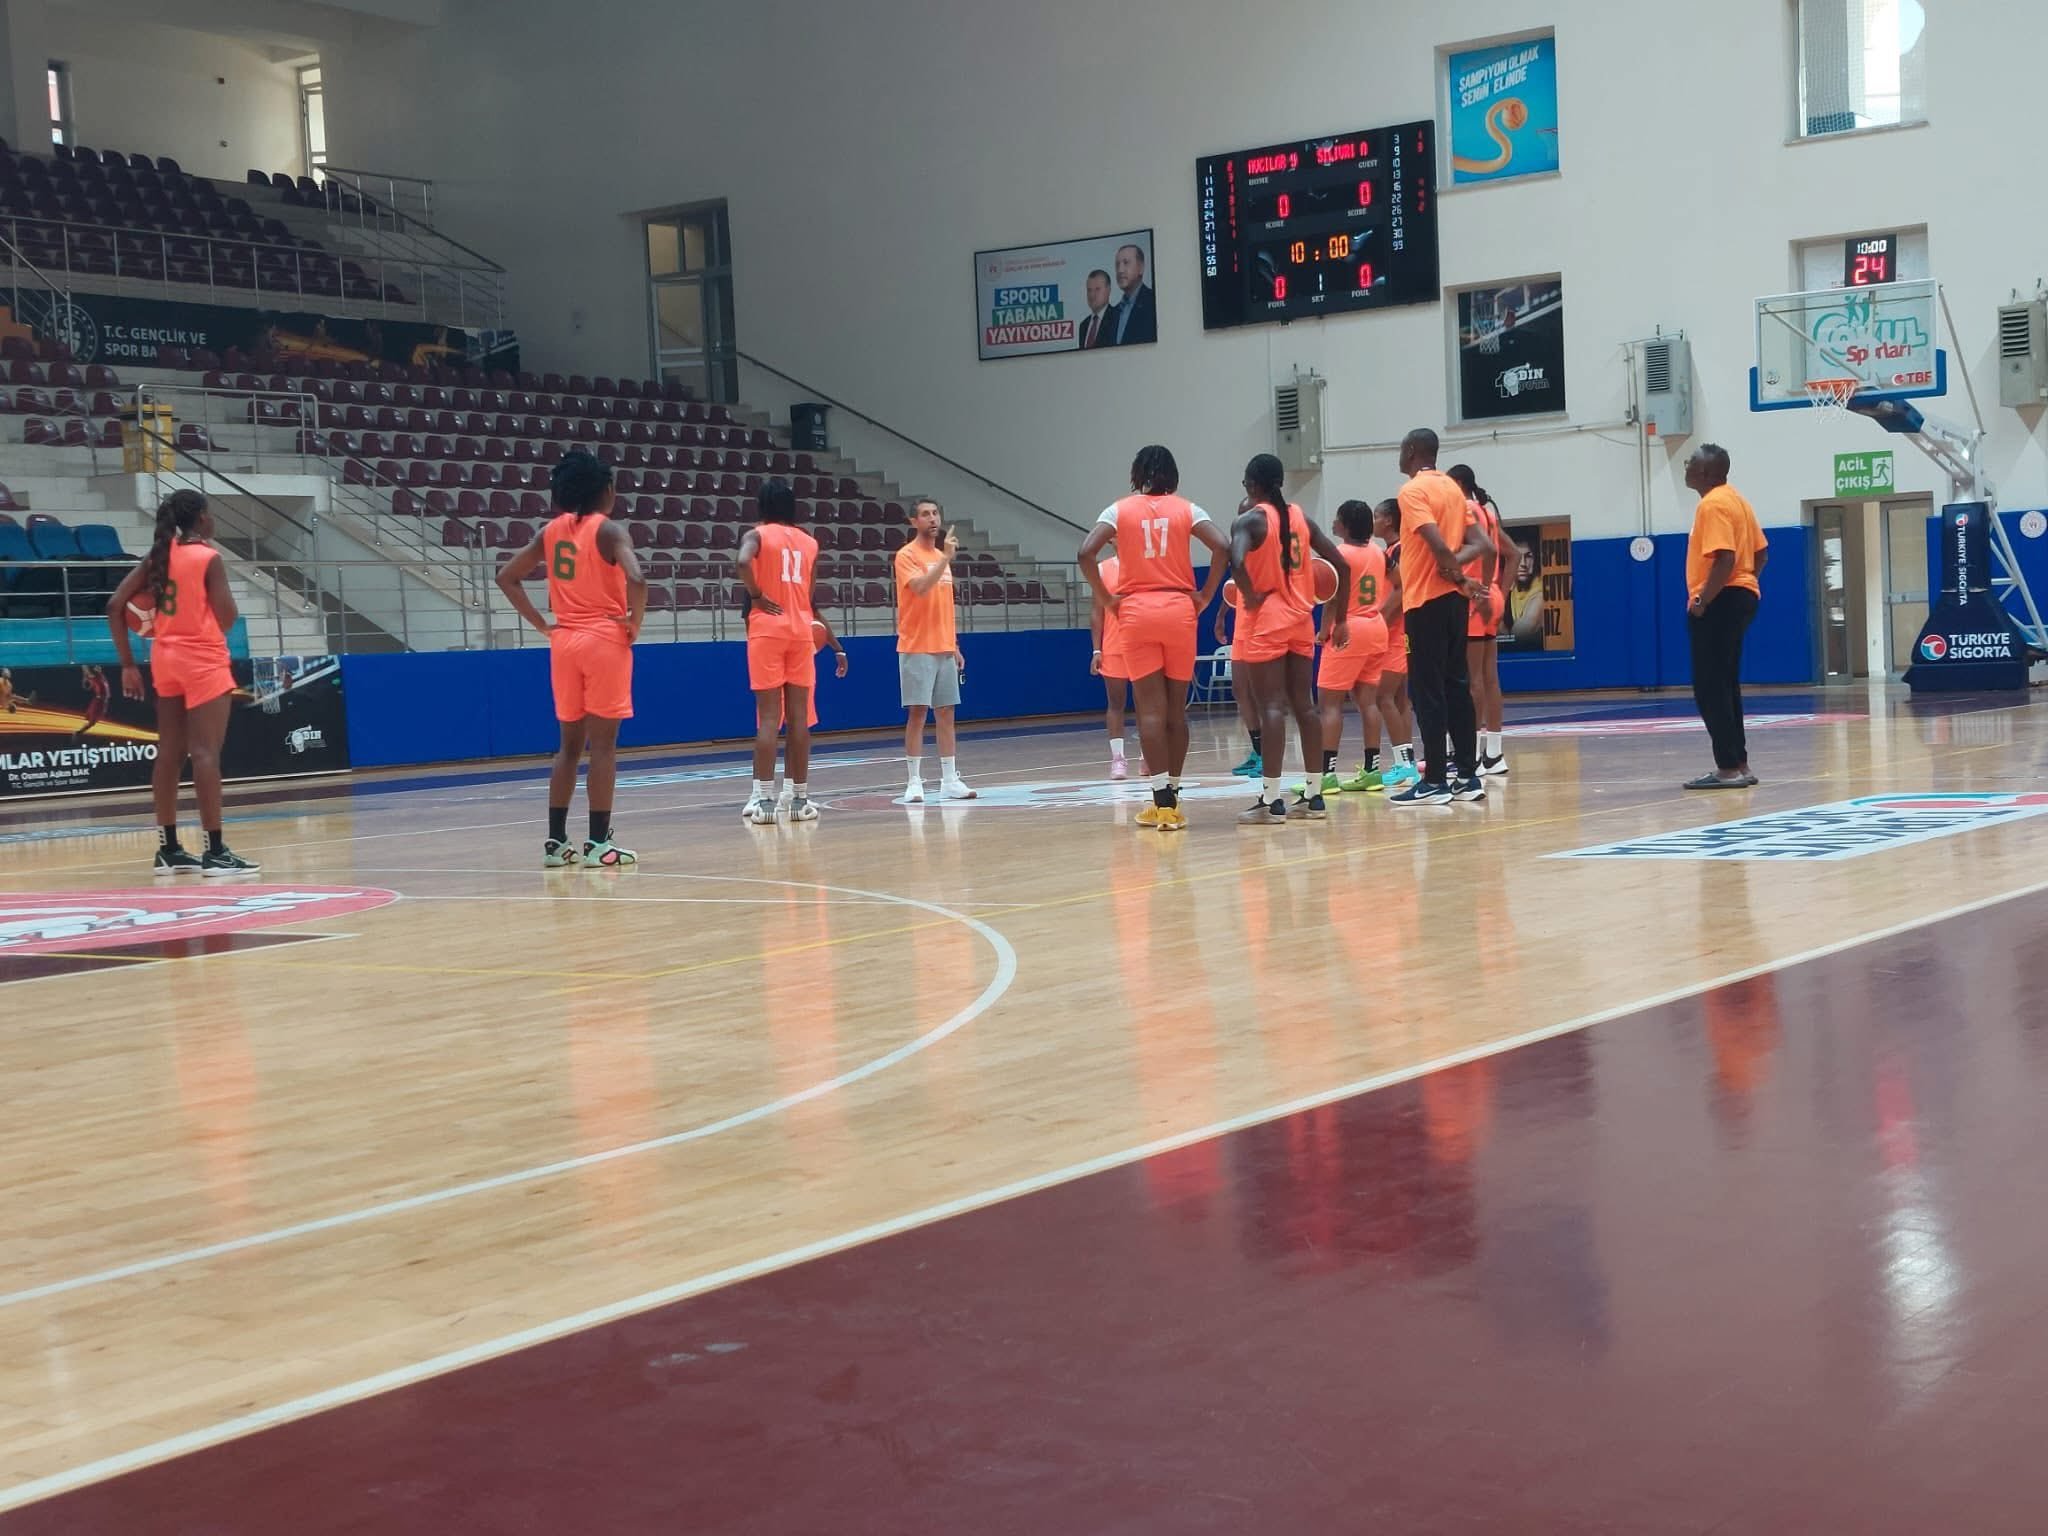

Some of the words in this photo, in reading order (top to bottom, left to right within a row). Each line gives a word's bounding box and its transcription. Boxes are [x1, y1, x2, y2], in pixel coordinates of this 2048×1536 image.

[1360, 181, 1371, 206] 0
[1278, 194, 1289, 218] 0
[1856, 240, 1887, 254] 10:00
[1360, 263, 1371, 288] 0
[1854, 256, 1886, 283] 24
[1000, 287, 1050, 306] SPORU
[1275, 275, 1287, 300] 0
[1311, 294, 1325, 303] SET
[1351, 289, 1370, 298] FOUL
[996, 304, 1058, 326] TABANA
[1268, 300, 1286, 309] FOUL
[190, 331, 207, 345] VE
[988, 321, 1073, 344] YAYIYORUZ
[104, 342, 139, 358] SPOR
[1838, 456, 1868, 472] ACİL
[1836, 475, 1870, 492] ÇIKIŞ
[1141, 517, 1169, 559] 17
[554, 541, 577, 580] 6
[781, 548, 802, 585] 11
[1358, 575, 1377, 606] 9
[1949, 646, 2012, 659] SİGORTA
[47, 741, 159, 769] YETİŞTİRİYO
